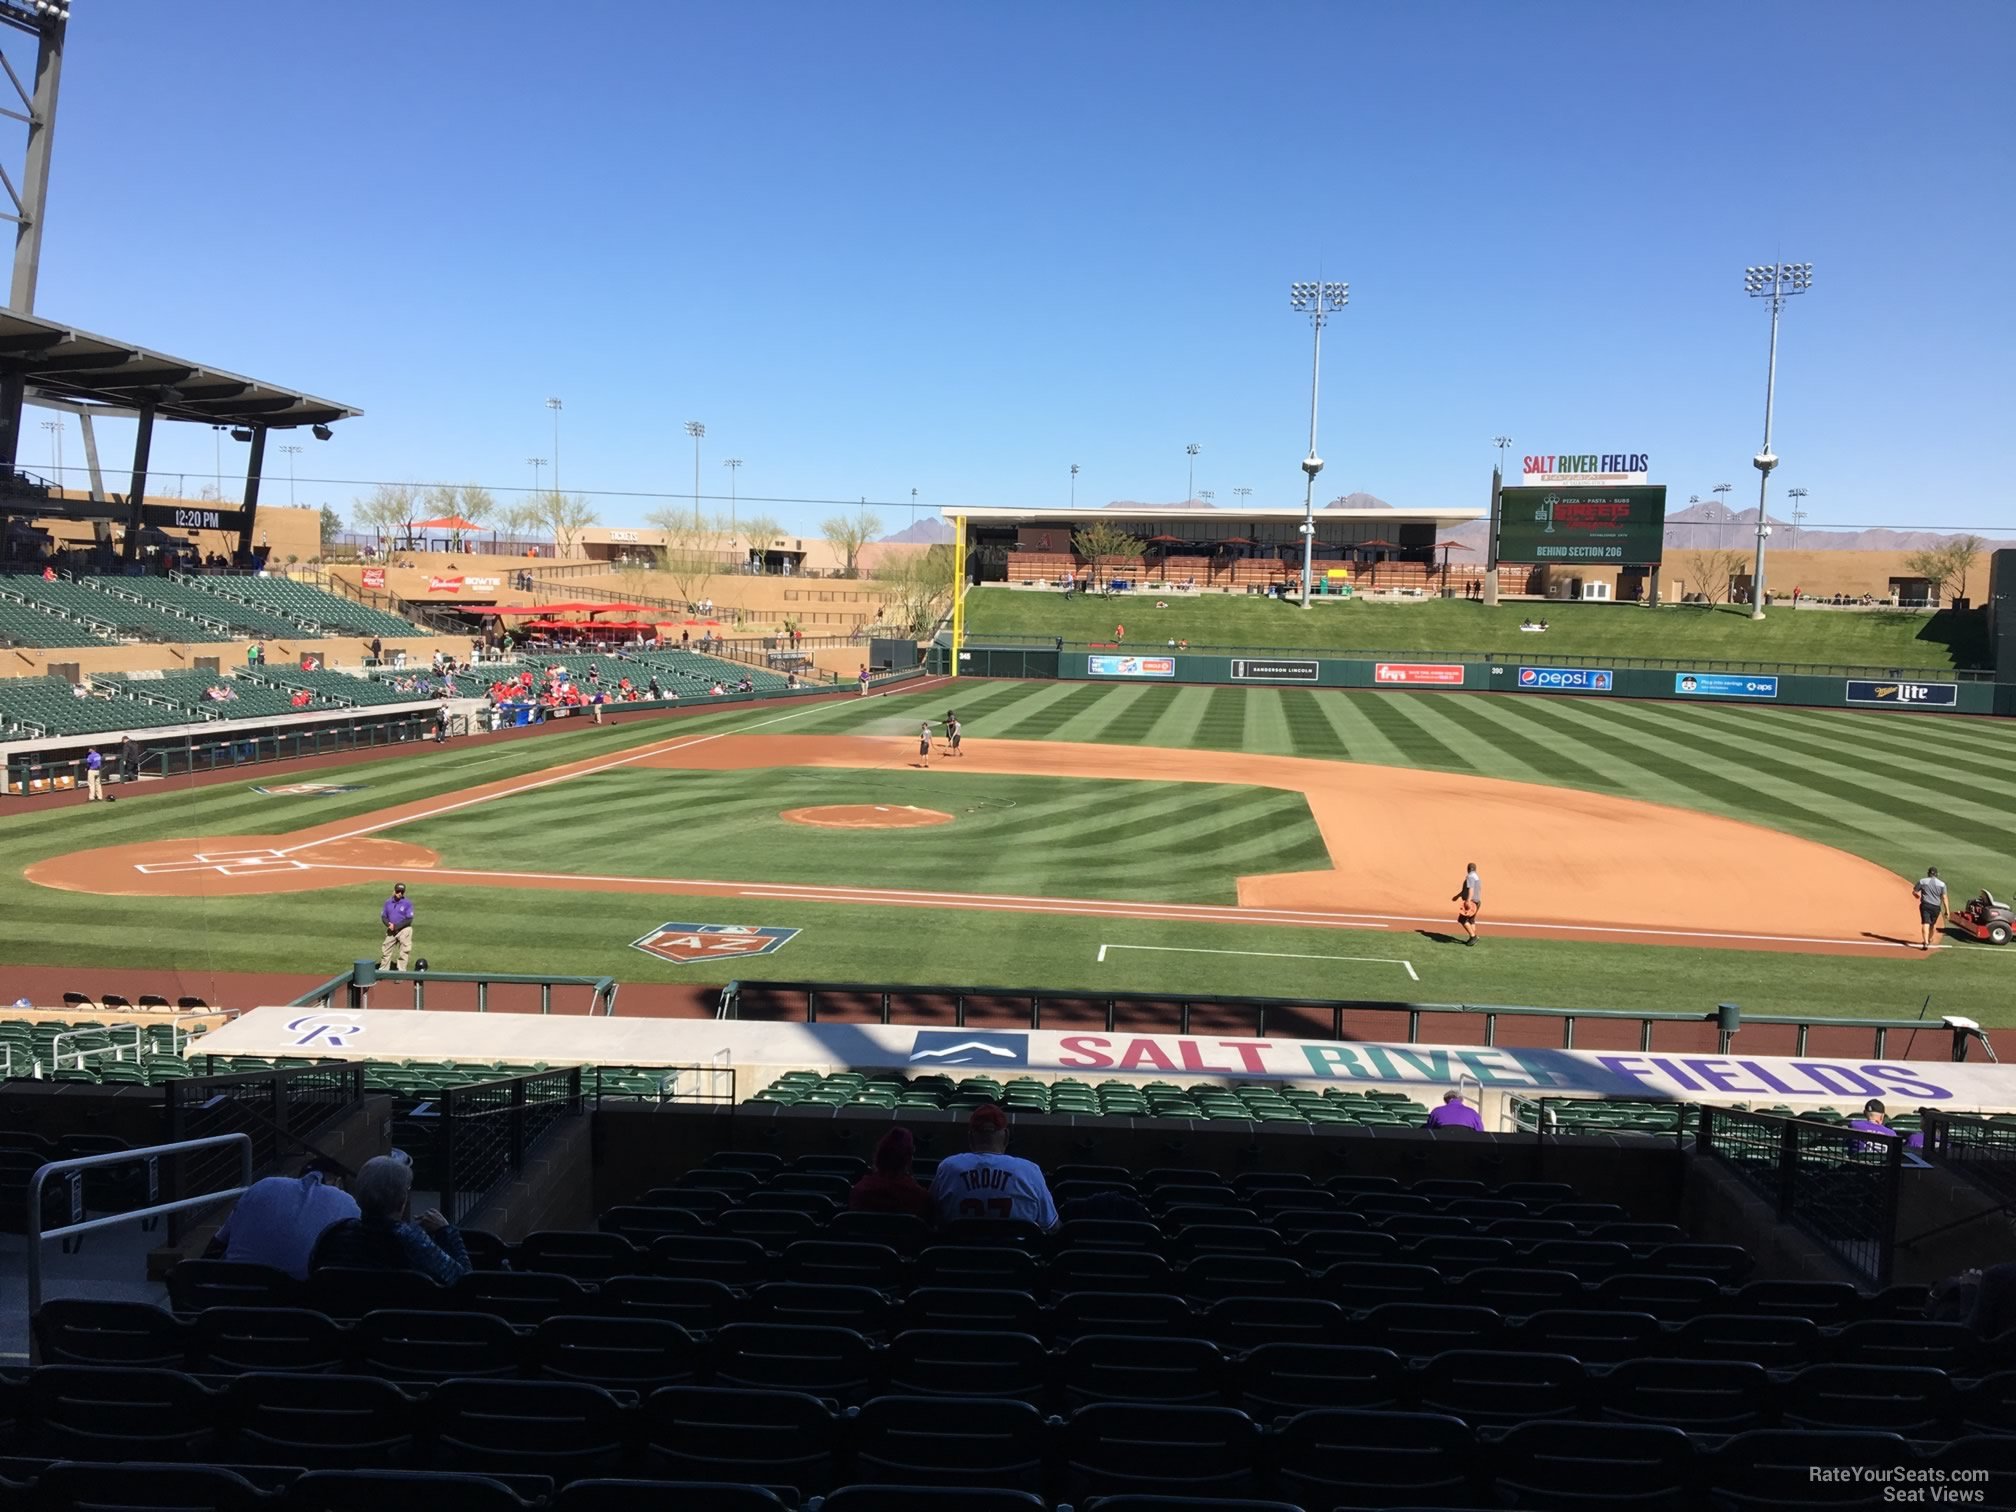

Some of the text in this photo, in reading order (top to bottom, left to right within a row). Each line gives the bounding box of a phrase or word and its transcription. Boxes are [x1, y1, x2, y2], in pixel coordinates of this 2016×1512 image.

[1523, 453, 1649, 474] SALT RIVER FIELDS
[175, 509, 219, 528] 12:20 PM
[608, 530, 640, 543] TICKETS
[1536, 546, 1622, 557] BEHIND SECTION 206
[1491, 666, 1504, 675] 390
[1538, 671, 1587, 687] pepsi
[1756, 683, 1773, 692] aps
[1896, 684, 1928, 702] Lite
[657, 935, 758, 952] AZ
[1058, 1036, 1272, 1074] SALT
[1595, 1055, 1954, 1100] FIELDS
[960, 1167, 1012, 1192] TROUT
